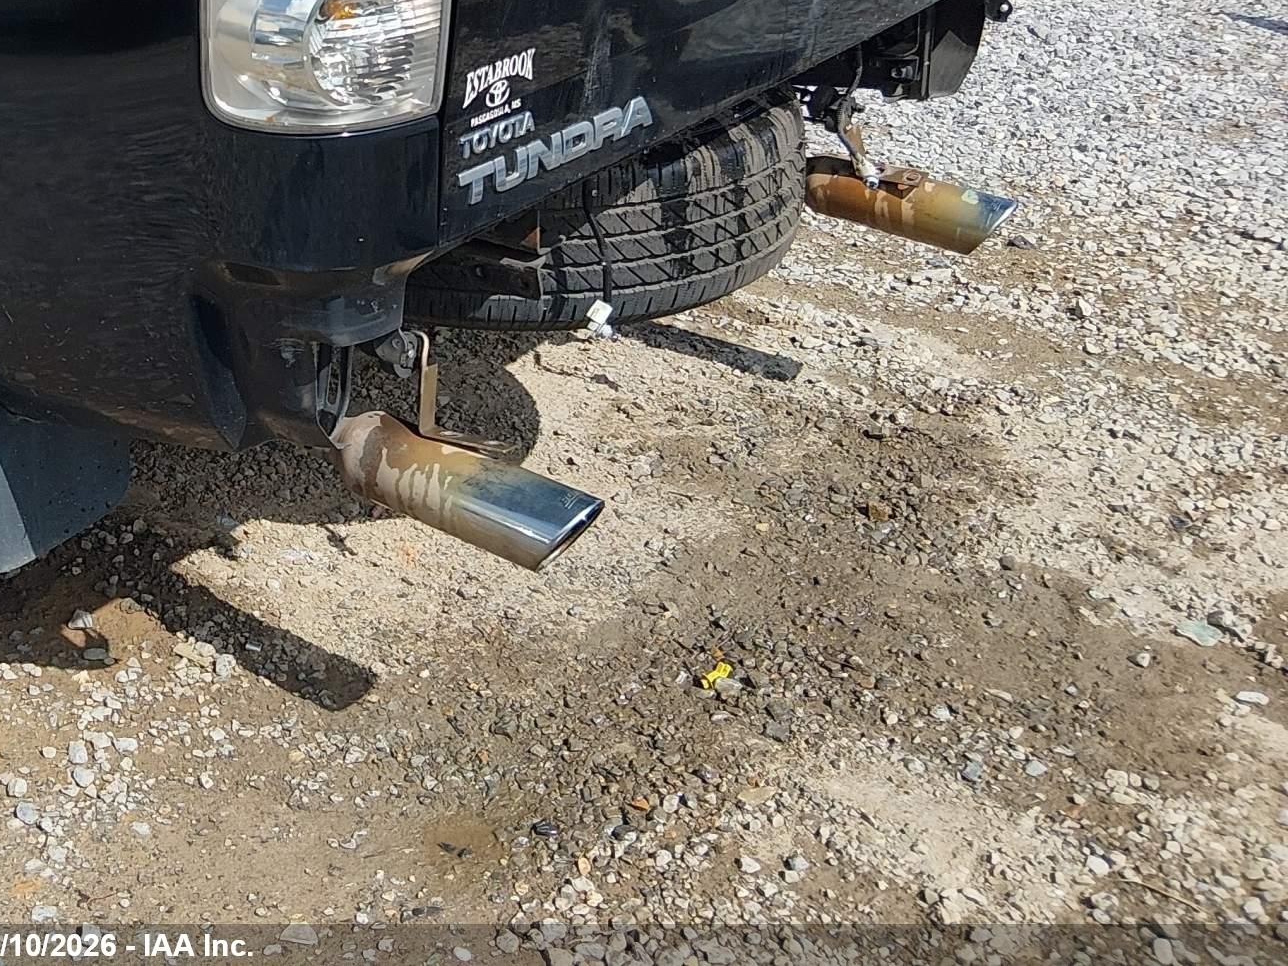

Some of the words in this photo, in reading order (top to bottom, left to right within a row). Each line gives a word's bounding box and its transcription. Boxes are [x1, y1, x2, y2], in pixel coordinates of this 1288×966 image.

[462, 47, 536, 109] ESTABROOK
[456, 95, 654, 205] TUNDRA
[458, 110, 536, 159] TOYOTA
